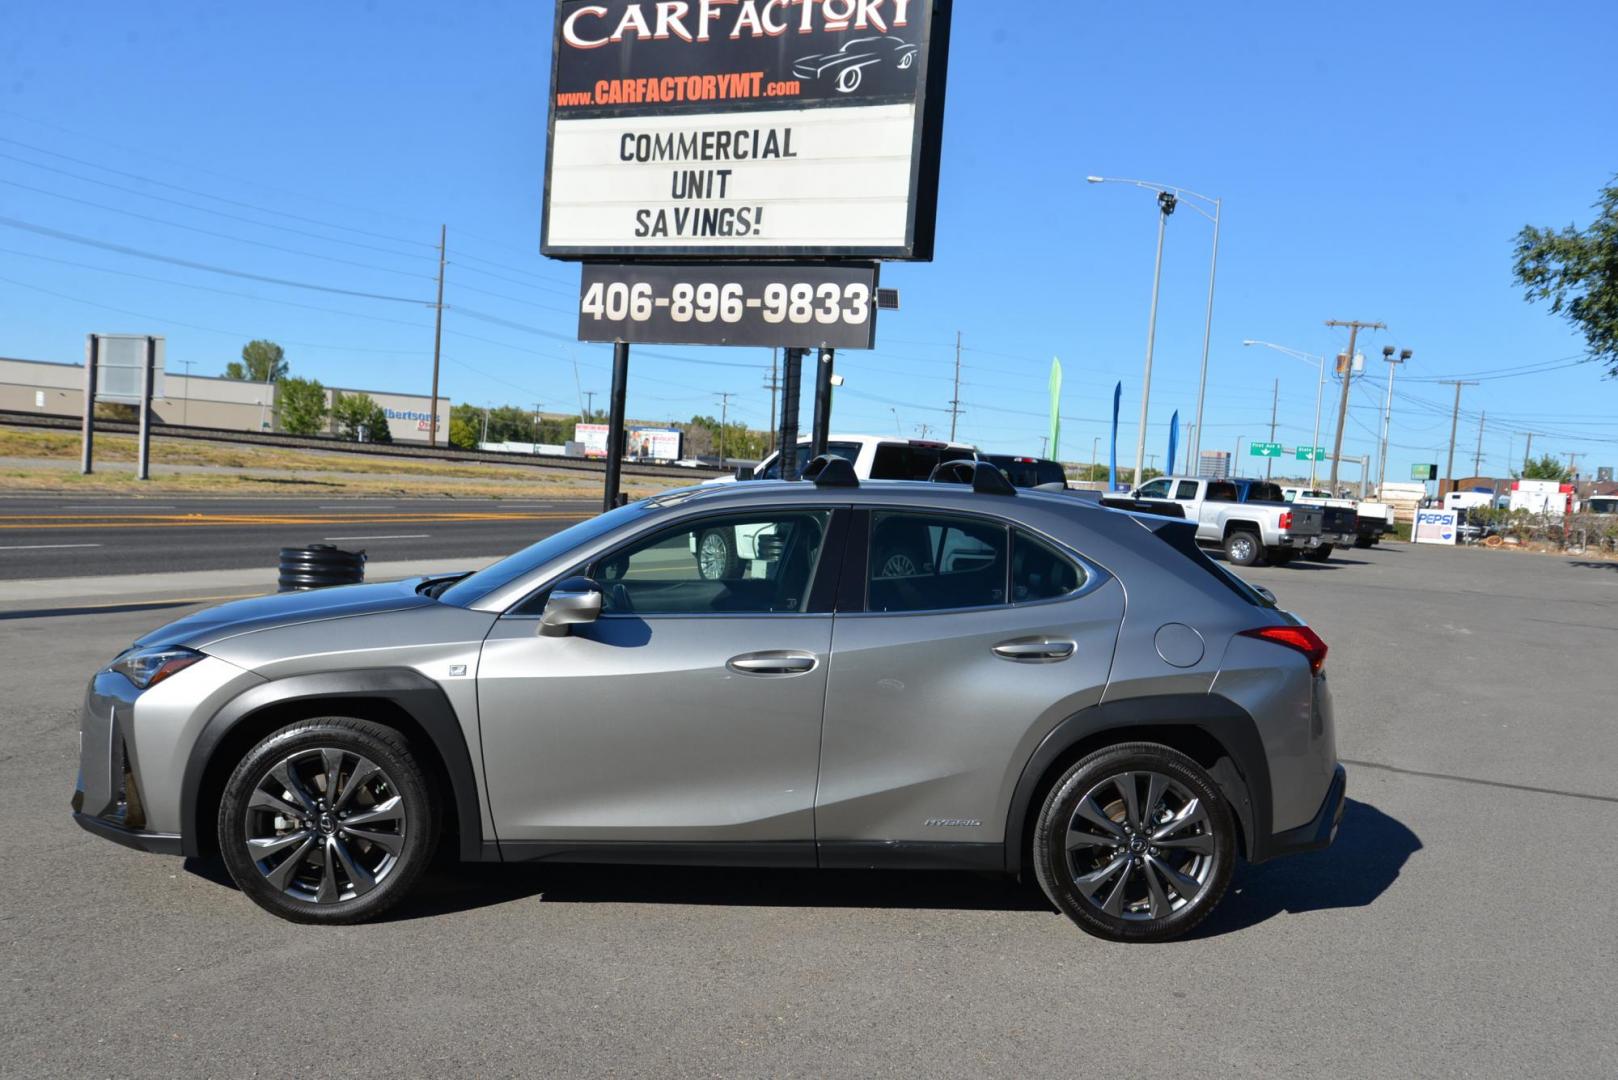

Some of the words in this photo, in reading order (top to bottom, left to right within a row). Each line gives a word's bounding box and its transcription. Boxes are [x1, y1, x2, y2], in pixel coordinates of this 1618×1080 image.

[557, 71, 800, 106] www.CARFACTORYMT.com
[620, 128, 797, 162] COMMERCIAL
[672, 169, 732, 199] UNIT
[635, 206, 763, 237] SAVINGS!
[581, 282, 869, 325] 406-896-9833
[1417, 514, 1454, 525] PEPSI
